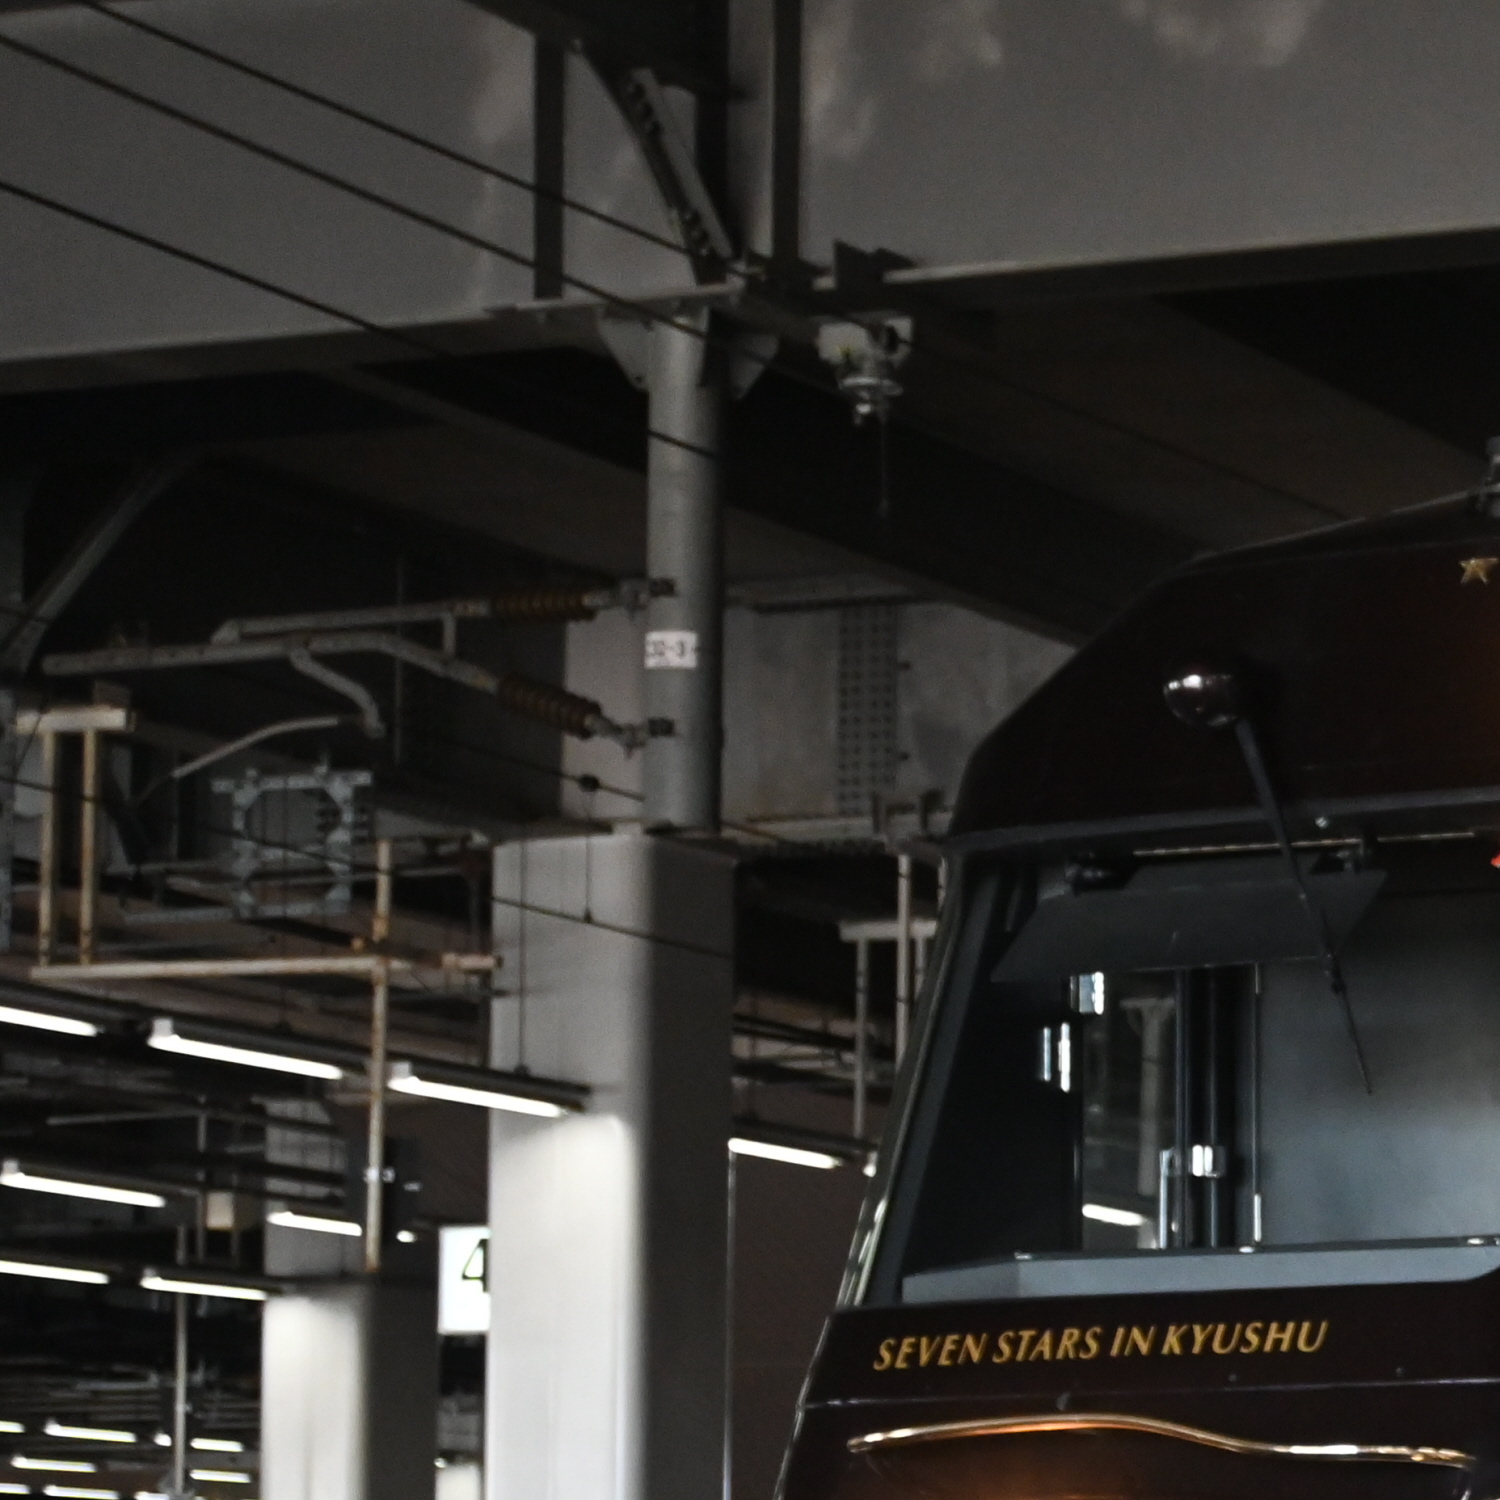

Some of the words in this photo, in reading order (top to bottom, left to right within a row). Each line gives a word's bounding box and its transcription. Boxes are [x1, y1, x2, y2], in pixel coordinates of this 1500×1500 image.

[873, 1332, 988, 1371] SEVEN
[992, 1326, 1103, 1364] STARS
[1109, 1325, 1157, 1357] IN
[1161, 1320, 1329, 1355] KYUSHU
